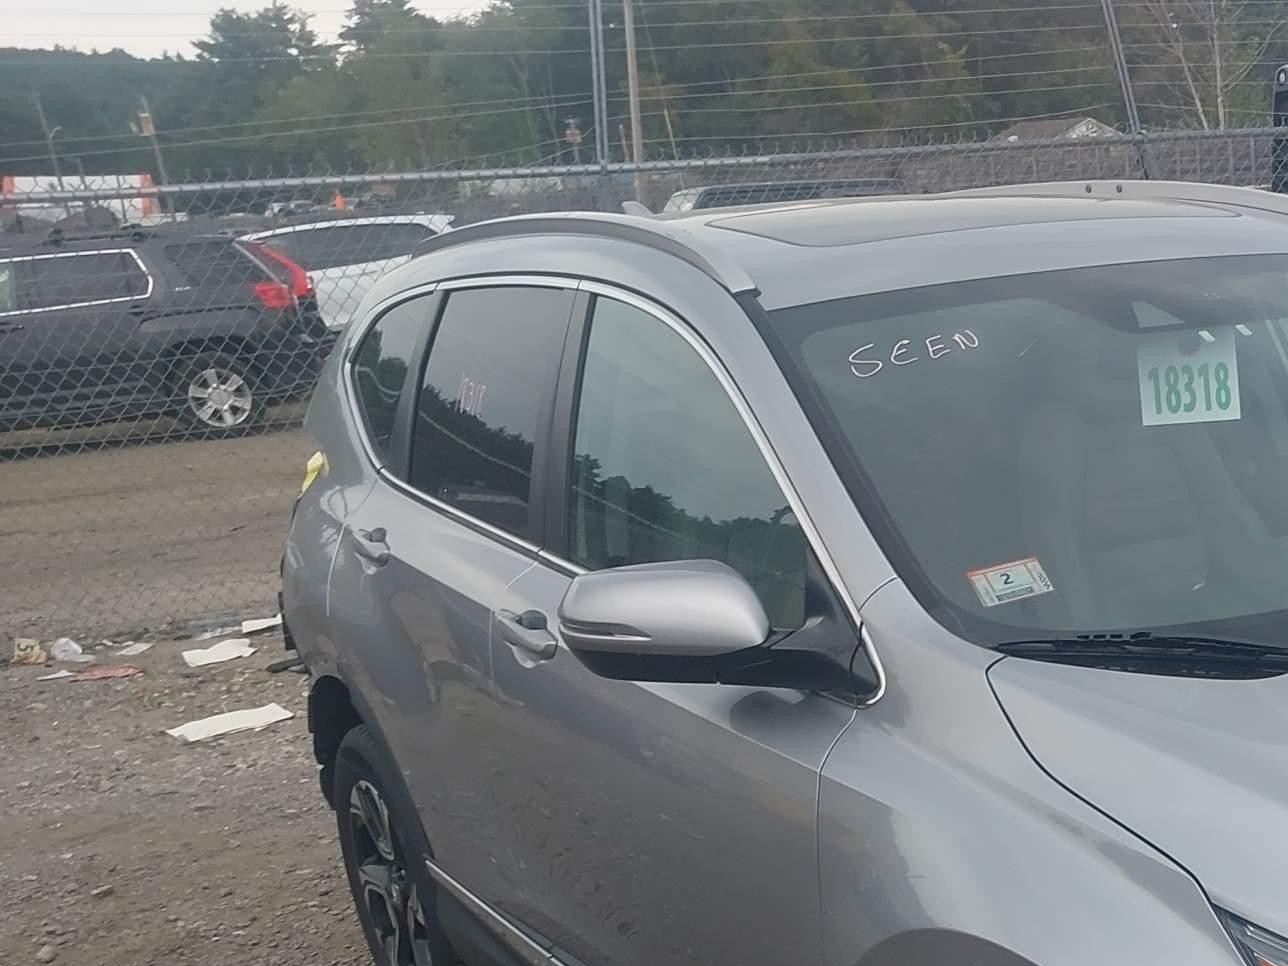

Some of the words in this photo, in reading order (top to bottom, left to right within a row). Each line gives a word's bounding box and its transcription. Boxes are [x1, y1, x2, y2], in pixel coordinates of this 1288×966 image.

[849, 329, 979, 378] SEEN
[1147, 361, 1232, 415] 18318
[1000, 573, 1015, 585] 2
